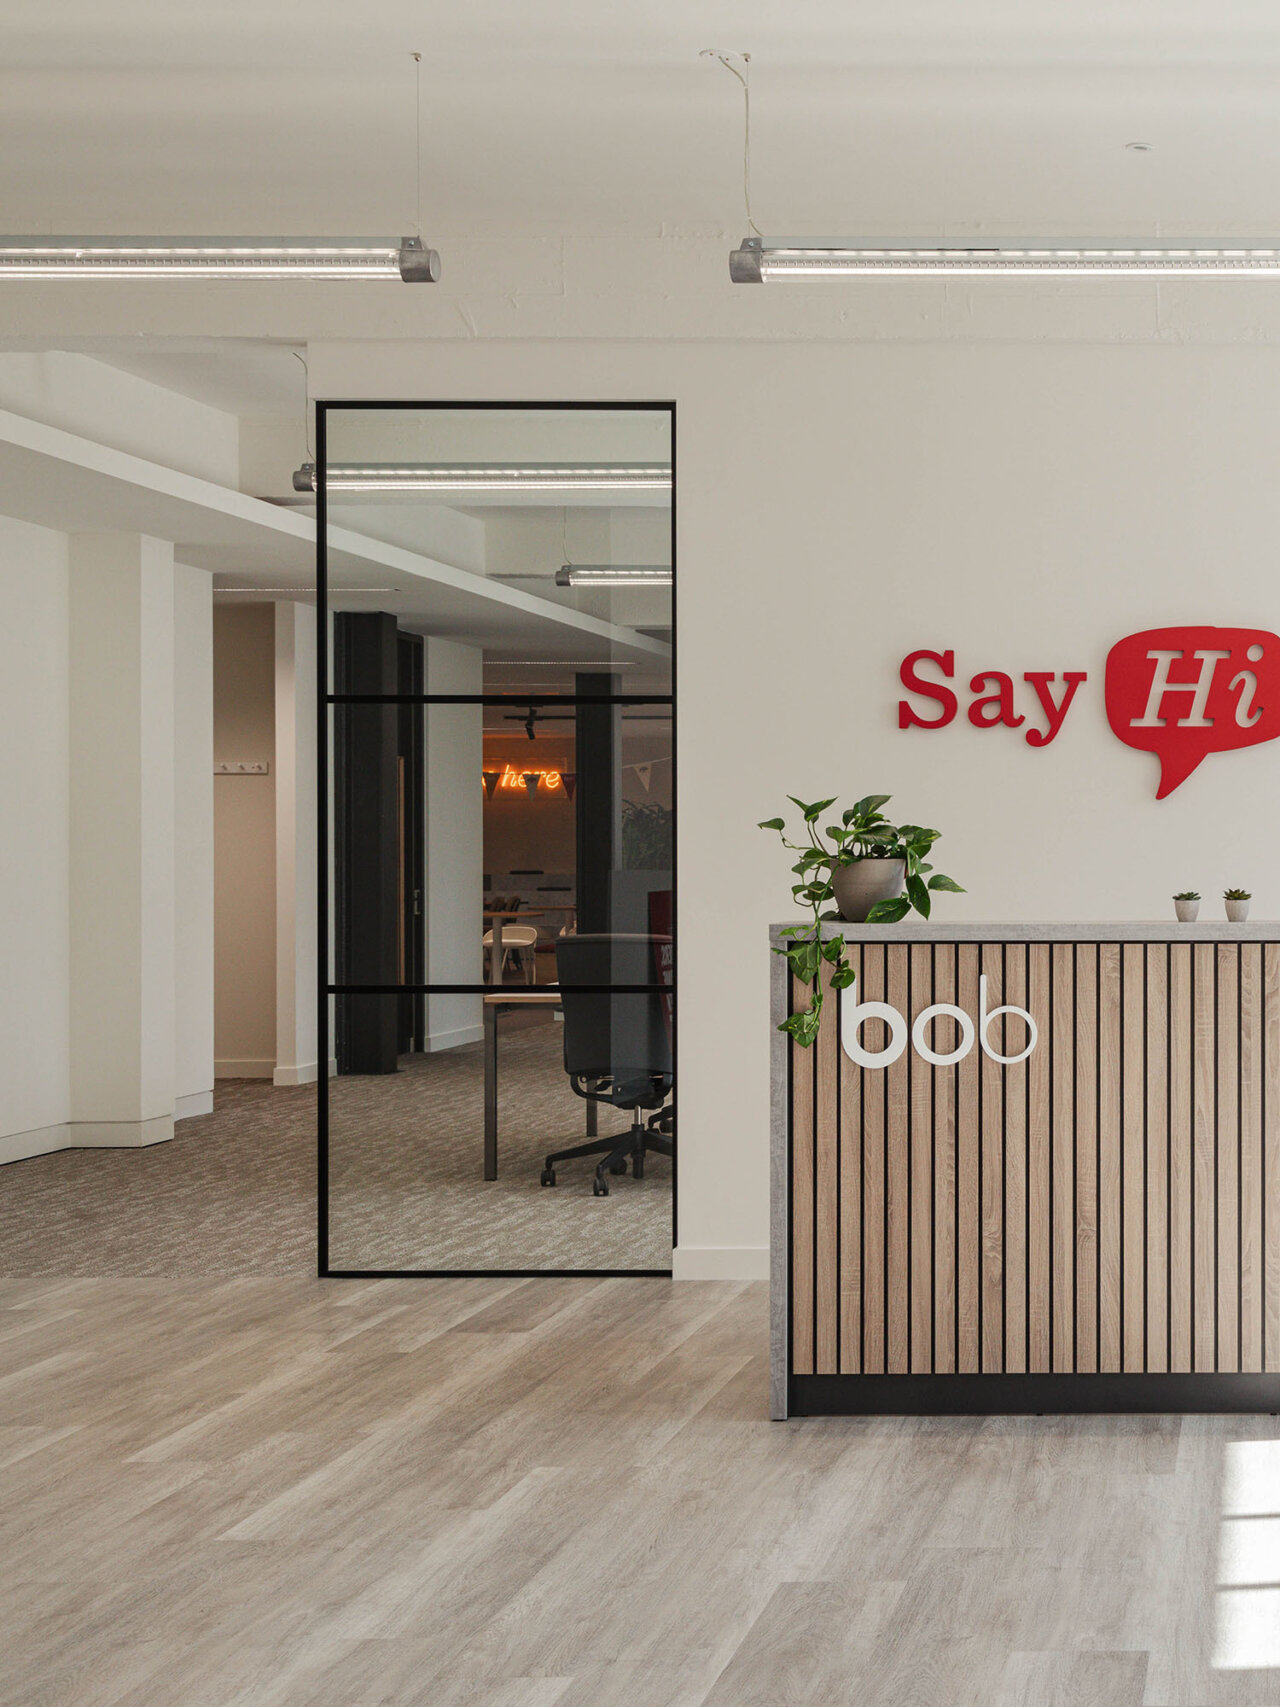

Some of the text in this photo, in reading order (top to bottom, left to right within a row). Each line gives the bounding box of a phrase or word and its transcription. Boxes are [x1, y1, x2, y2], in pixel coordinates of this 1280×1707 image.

[899, 649, 1087, 748] Say
[1129, 644, 1264, 728] Hi
[841, 973, 1038, 1069] bob
